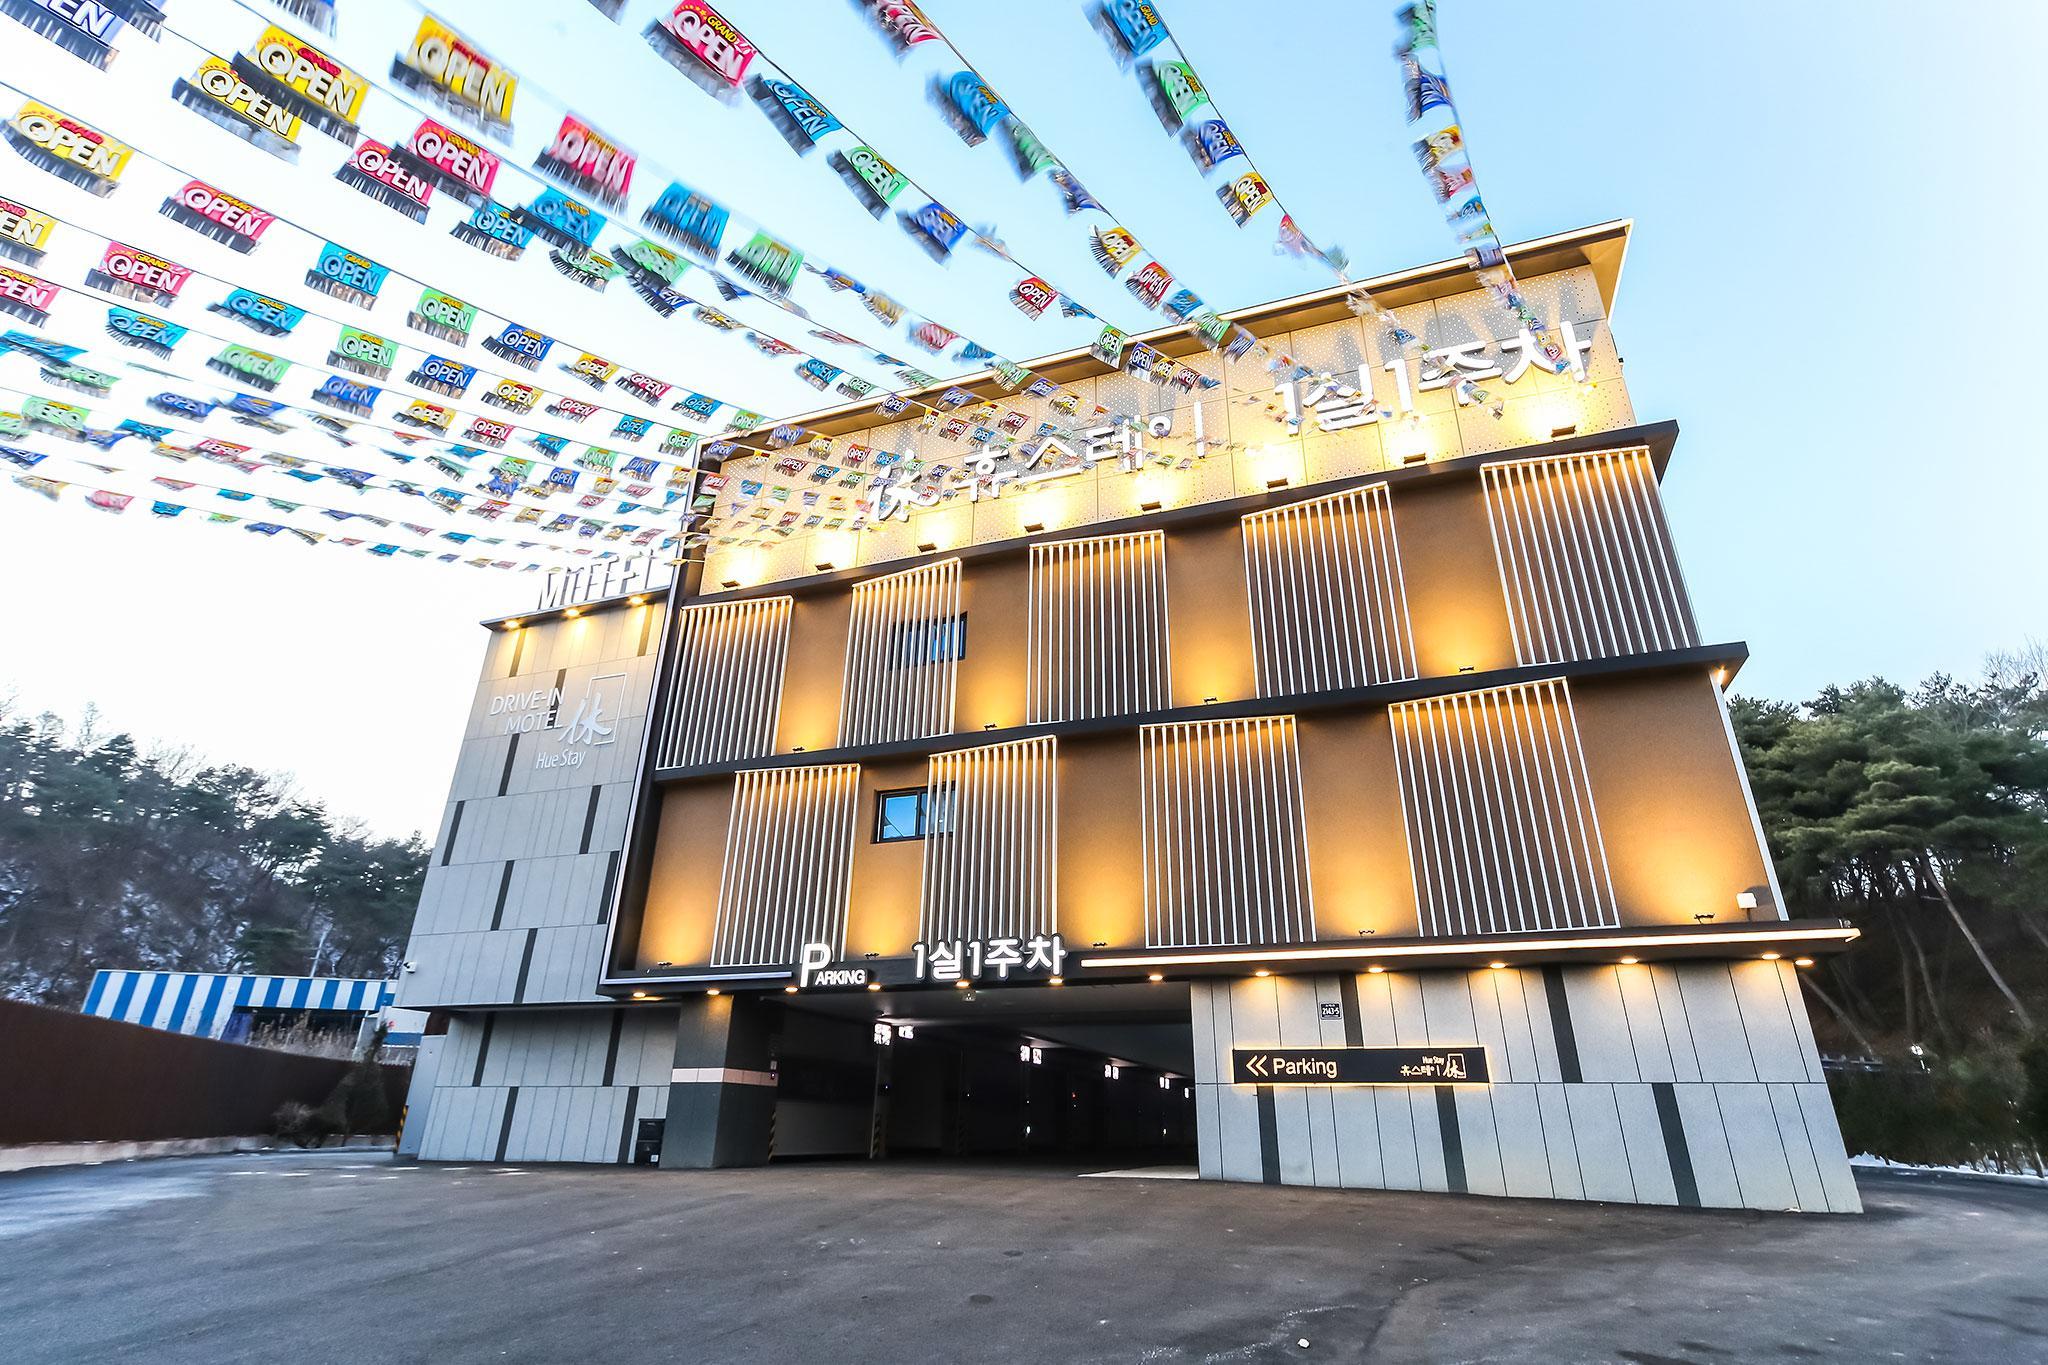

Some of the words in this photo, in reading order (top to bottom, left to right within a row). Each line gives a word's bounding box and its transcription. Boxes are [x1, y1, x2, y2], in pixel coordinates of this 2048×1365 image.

[42, 0, 116, 38] EN
[707, 15, 737, 43] GRAND
[1140, 5, 1158, 26] GRAND
[672, 11, 744, 79] OPEN
[259, 42, 357, 117] OPEN
[418, 37, 510, 114] OPEN
[201, 68, 294, 136] OPEN
[771, 81, 828, 136] OPEN
[19, 115, 121, 176] OPEN
[414, 131, 490, 188] OPEN
[560, 131, 630, 191] OPEN
[357, 150, 427, 199] OPEN
[851, 150, 900, 199] OPEN
[1234, 177, 1265, 213] OPEN
[184, 187, 262, 236] OPEN
[0, 209, 44, 246] EN
[475, 212, 527, 244] OPEN
[108, 253, 180, 292] OPEN
[323, 255, 380, 291] OPEN
[1140, 269, 1168, 296] OPEN
[0, 276, 49, 308] PEN
[1018, 282, 1052, 308] OPEN
[230, 296, 298, 328] OPEN
[421, 298, 470, 331] OPEN
[110, 314, 177, 345] OPEN
[1101, 332, 1121, 354] OPEN
[341, 335, 392, 366] OPEN
[503, 331, 547, 359] OPEN
[224, 349, 282, 380] OPEN
[577, 360, 610, 379] OPEN
[807, 360, 835, 380] OPEN
[1133, 352, 1150, 369] OPEN
[424, 363, 468, 387] OPEN
[631, 374, 665, 396] OPEN
[1179, 369, 1197, 384] OPEN
[328, 378, 374, 404] OPEN
[497, 384, 537, 405] OPEN
[409, 406, 450, 426] OPEN
[560, 399, 593, 415] OPEN
[686, 398, 713, 414] OPEN
[474, 420, 508, 438] OPEN
[619, 421, 645, 434] OPEN
[735, 415, 758, 429] OPEN
[947, 420, 966, 434] OPEN
[668, 433, 693, 448] OPEN
[585, 450, 613, 466] OPEN
[630, 459, 653, 473] OPEN
[782, 458, 805, 472] OPEN
[848, 448, 868, 461] OPEN
[551, 472, 575, 485] OPEN
[489, 686, 567, 716] DRIVE-IN
[504, 709, 563, 735] MOTEL
[558, 692, 612, 746] 休
[535, 751, 559, 770] Hue
[560, 748, 587, 770] Stay
[912, 935, 1066, 980] 1실1주차
[1273, 1058, 1337, 1078] Parking
